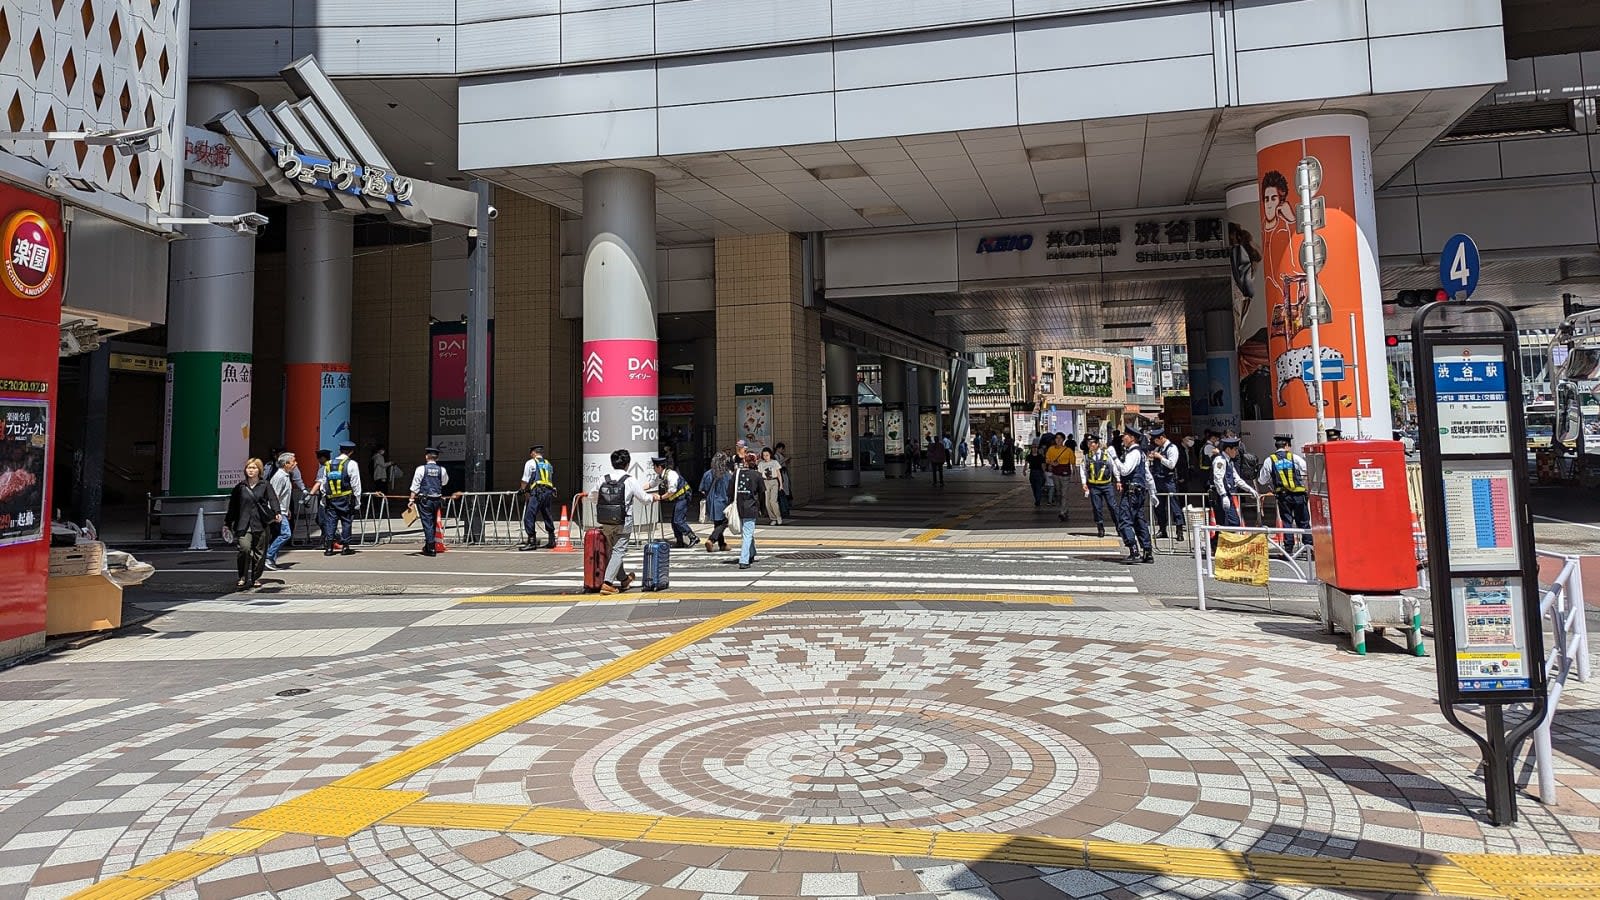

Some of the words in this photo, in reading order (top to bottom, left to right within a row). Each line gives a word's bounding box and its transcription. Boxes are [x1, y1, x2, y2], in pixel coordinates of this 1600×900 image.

[1135, 217, 1223, 246] 渋谷駅
[976, 234, 1034, 254] KEIO
[13, 238, 50, 272] 楽園
[1135, 249, 1194, 264] Shibuya
[1450, 242, 1470, 287] 4
[1067, 362, 1109, 384] サンドラッグ
[1438, 365, 1498, 378] 渋谷駅
[6, 412, 31, 422] 楽園全店
[6, 422, 45, 436] プロジェクト
